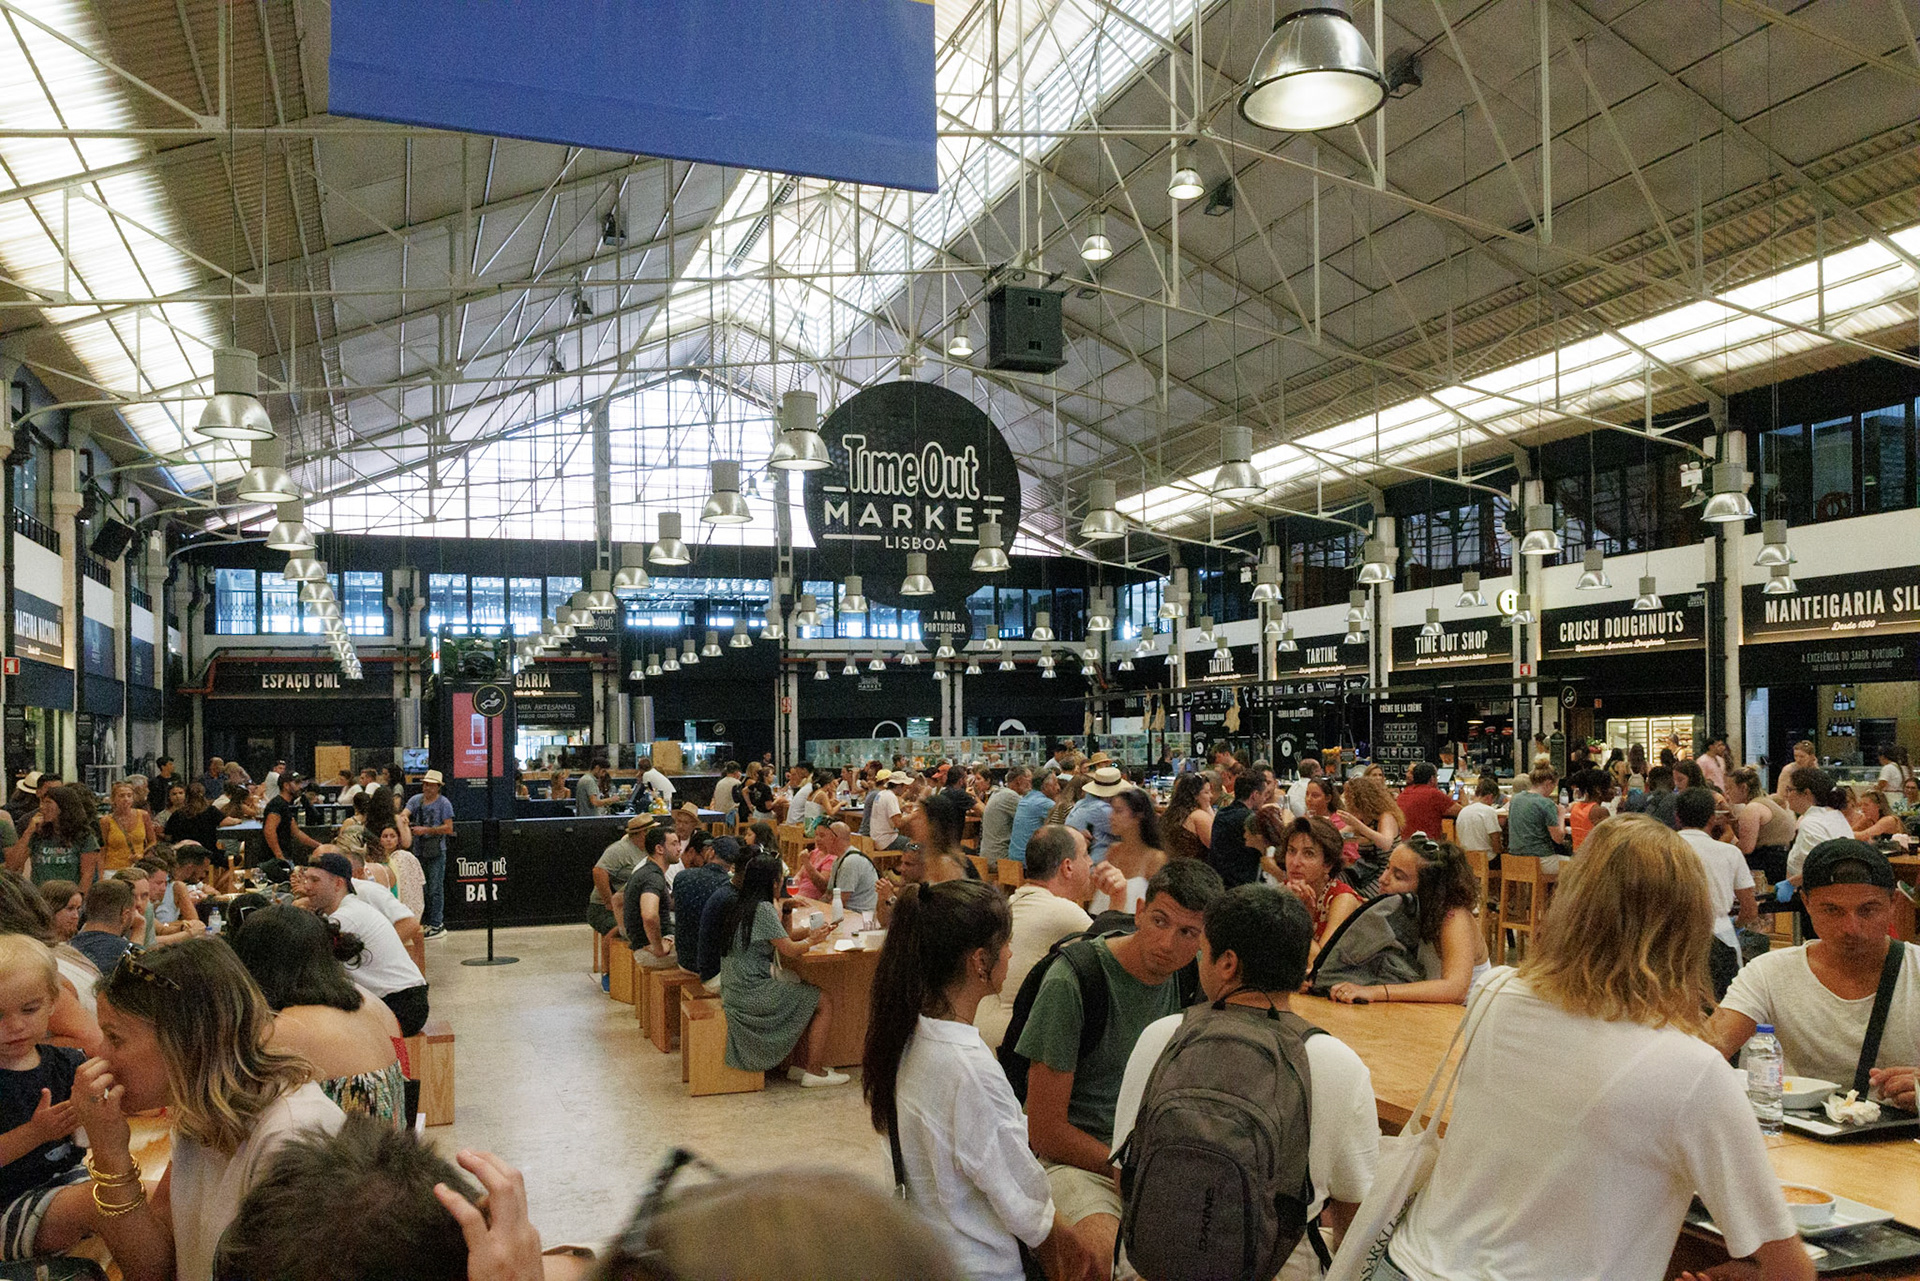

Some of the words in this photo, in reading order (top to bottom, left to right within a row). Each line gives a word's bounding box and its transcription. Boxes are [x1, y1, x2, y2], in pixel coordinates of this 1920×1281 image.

[842, 434, 920, 497] Time
[921, 441, 980, 501] Out
[824, 500, 1003, 532] MARKET
[885, 535, 947, 551] LISBOA
[1765, 589, 1885, 623] MANTEIGARIA
[933, 611, 938, 621] A
[940, 611, 956, 621] VIDA
[923, 622, 966, 633] PORTUGUESA
[1559, 619, 1599, 643] CRUSH
[1604, 610, 1684, 639] DOUGHNUTS
[1831, 621, 1857, 632] Desde
[1414, 636, 1438, 655] TIME
[1440, 633, 1459, 652] OUT
[1461, 630, 1488, 650] SHOP
[1306, 646, 1338, 664] TARTINE
[1208, 657, 1234, 674] TARTINE
[262, 673, 310, 692] ESPAÇO
[315, 673, 341, 689] CML
[1400, 703, 1407, 713] LA
[456, 857, 485, 877] Time
[465, 884, 498, 902] BAR
